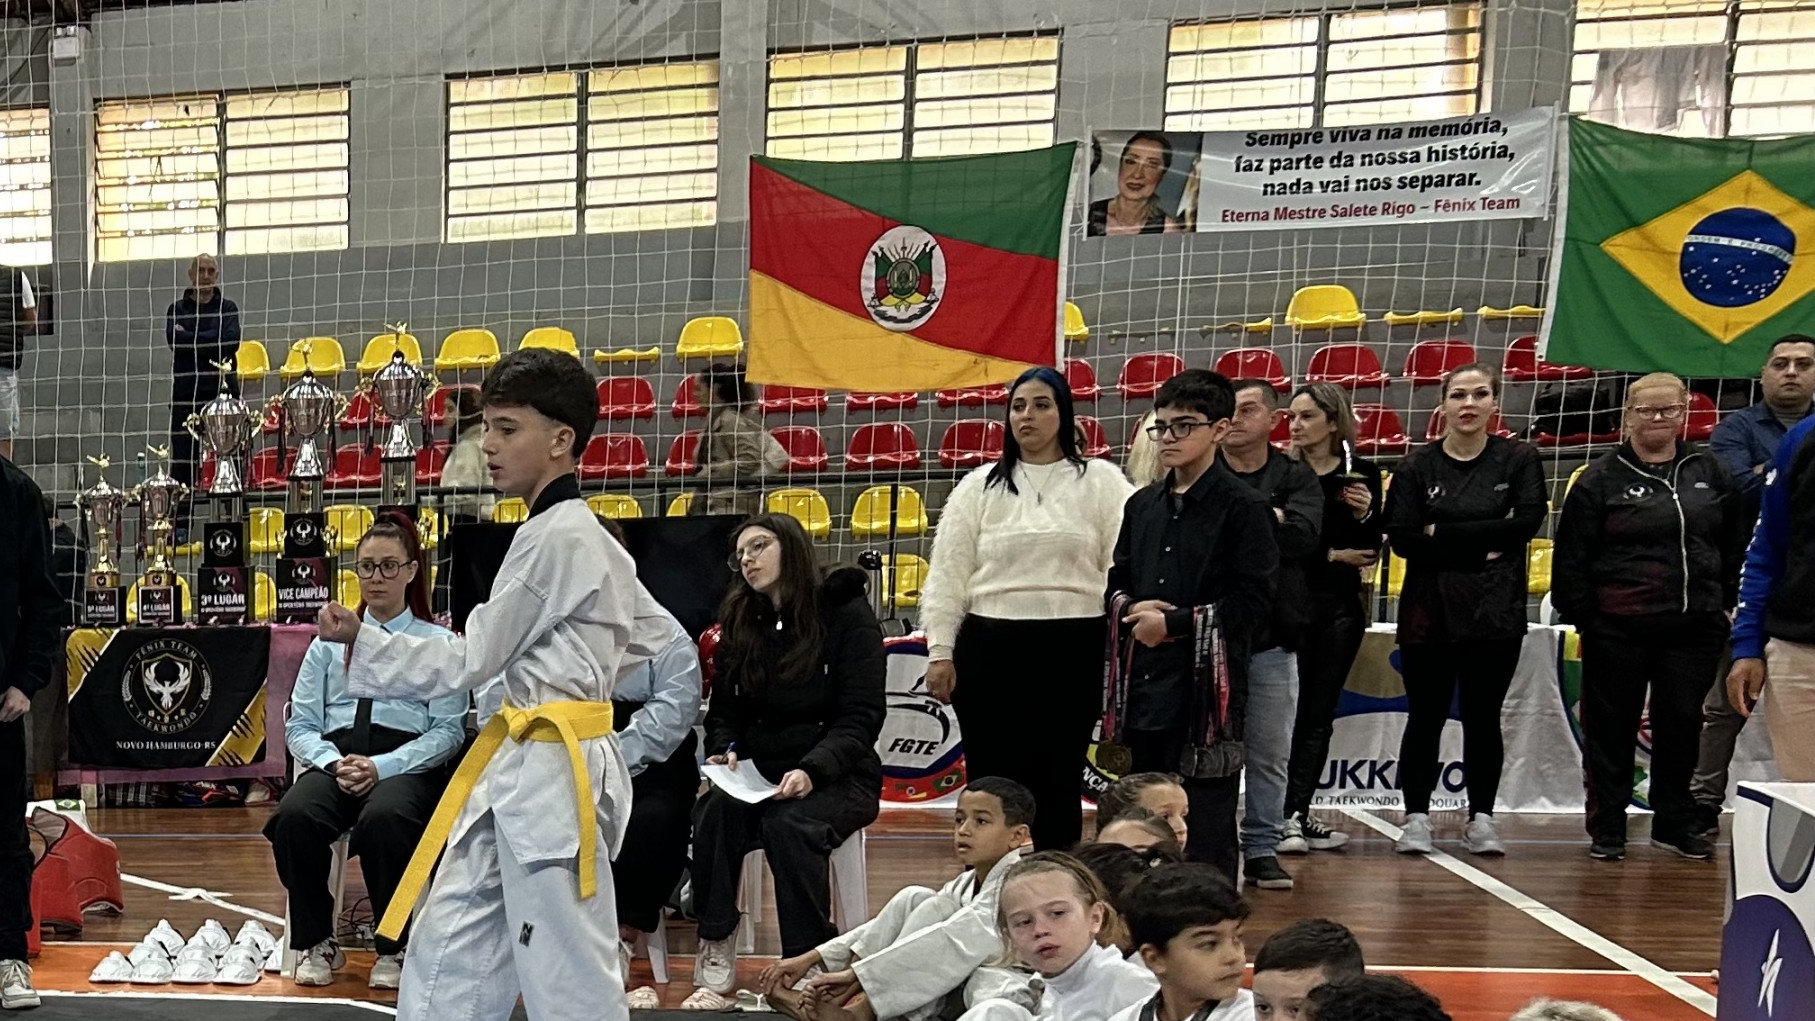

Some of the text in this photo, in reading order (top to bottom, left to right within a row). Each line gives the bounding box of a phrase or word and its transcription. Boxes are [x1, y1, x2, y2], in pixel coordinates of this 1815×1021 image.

[1245, 117, 1508, 149] Sempre viva na memória,
[1234, 142, 1515, 175] faz parte da nossa história,
[1262, 170, 1482, 196] nada vai nos separar.
[1221, 208, 1270, 223] Eterna
[1273, 203, 1327, 221] Mestre
[1330, 200, 1378, 218] Salete
[1380, 197, 1416, 217] Rigo
[1434, 194, 1476, 214] Fênix
[1479, 195, 1521, 211] Team
[213, 594, 245, 605] LUGAR
[278, 586, 329, 600] VICE CAMPEÃO
[171, 641, 198, 659] TEAM
[136, 711, 197, 733] TAEKWONDO
[116, 741, 144, 749] NOVO
[888, 738, 939, 755] FGTE
[1329, 795, 1400, 806] TAEKWONDO
